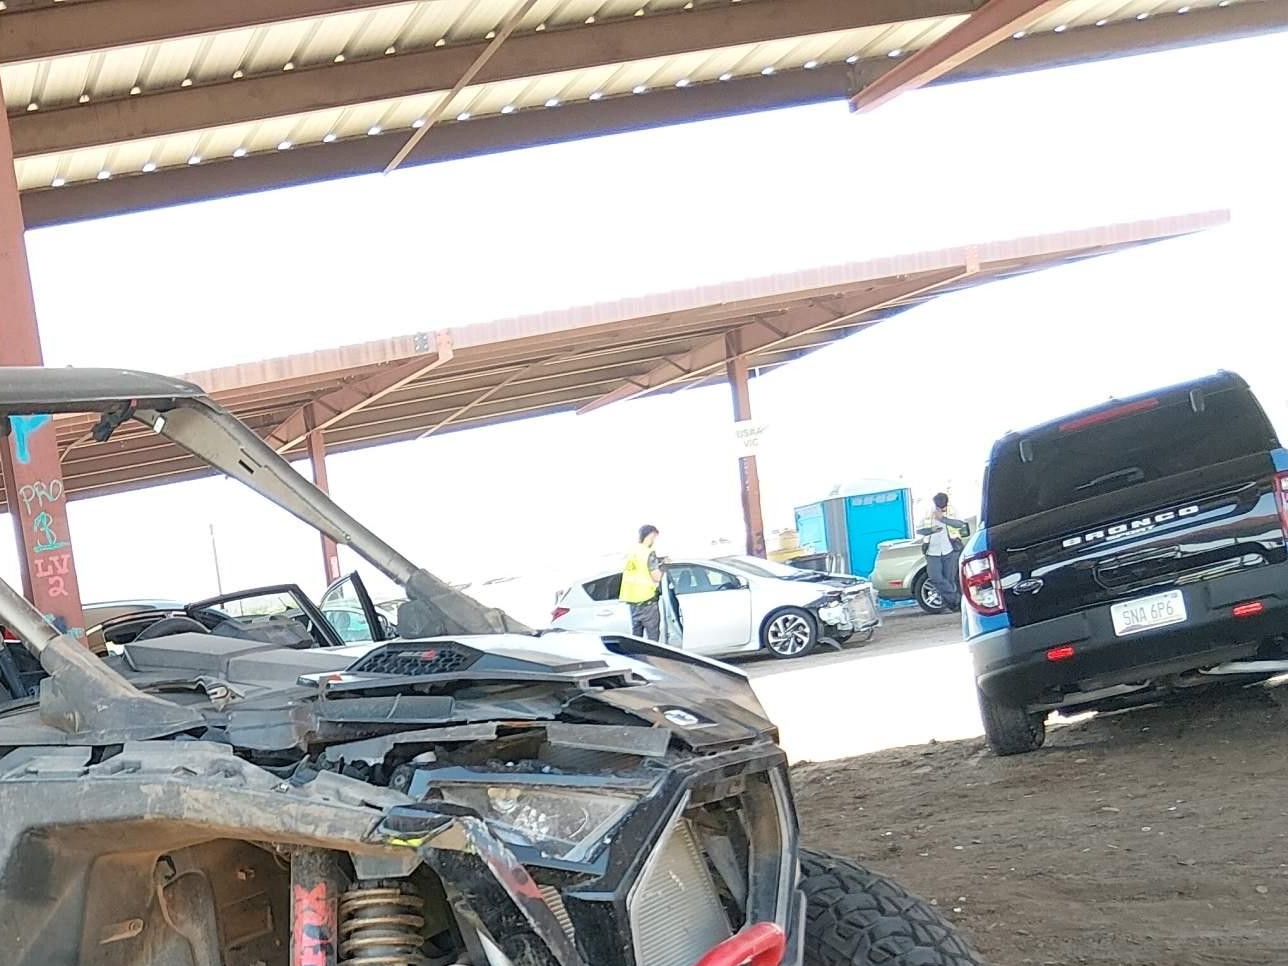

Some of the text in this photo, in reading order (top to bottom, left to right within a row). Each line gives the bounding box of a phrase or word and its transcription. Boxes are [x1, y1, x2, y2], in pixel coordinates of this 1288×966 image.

[1062, 505, 1200, 548] BRONCO
[34, 554, 70, 578] LV
[48, 575, 69, 597] 2
